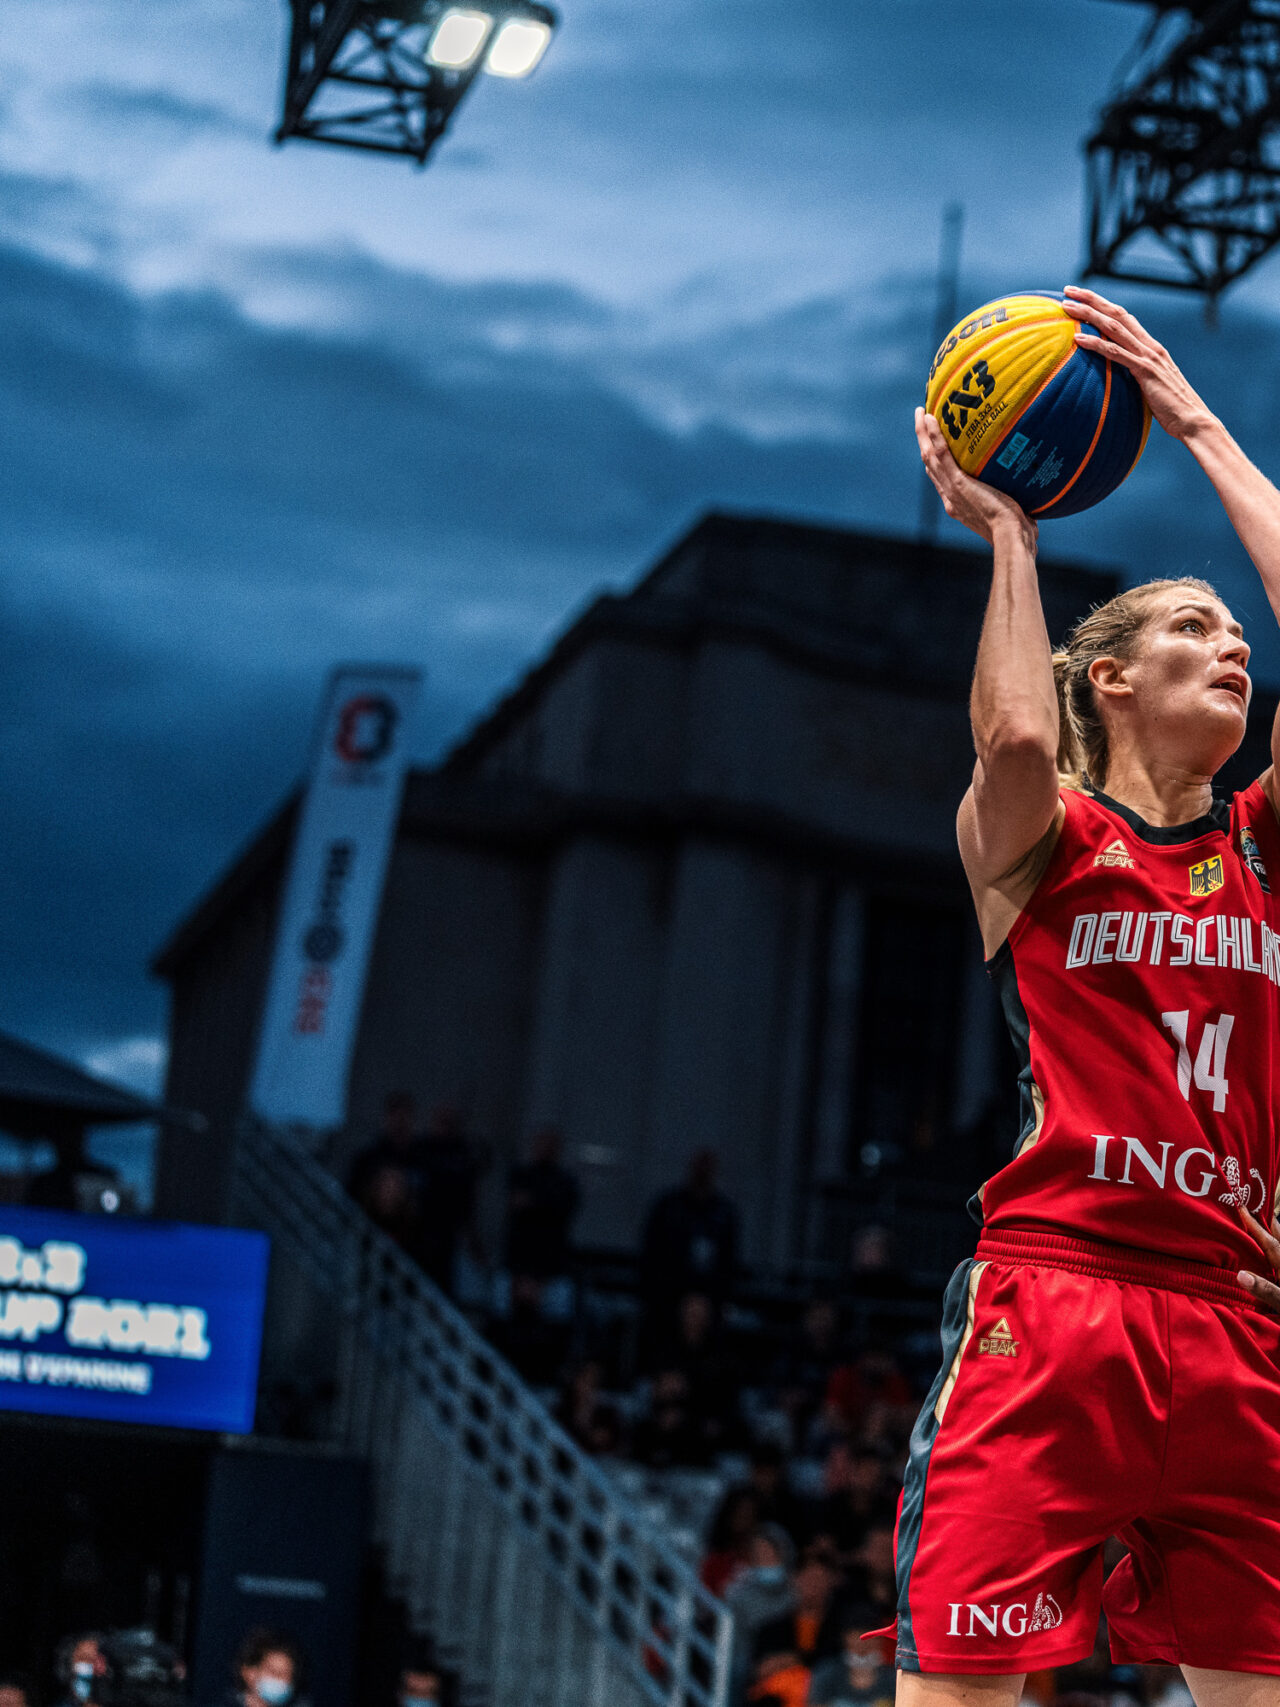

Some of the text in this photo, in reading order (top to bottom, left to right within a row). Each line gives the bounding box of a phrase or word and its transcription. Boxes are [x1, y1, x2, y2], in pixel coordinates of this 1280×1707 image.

[965, 418, 981, 439] FIBA
[967, 401, 1009, 455] OFFICIAL BALL
[1092, 854, 1136, 870] PEAK
[1162, 1009, 1235, 1113] 14
[1087, 1134, 1218, 1197] ING
[978, 1337, 1020, 1357] PEAK
[946, 1602, 1029, 1637] ING
